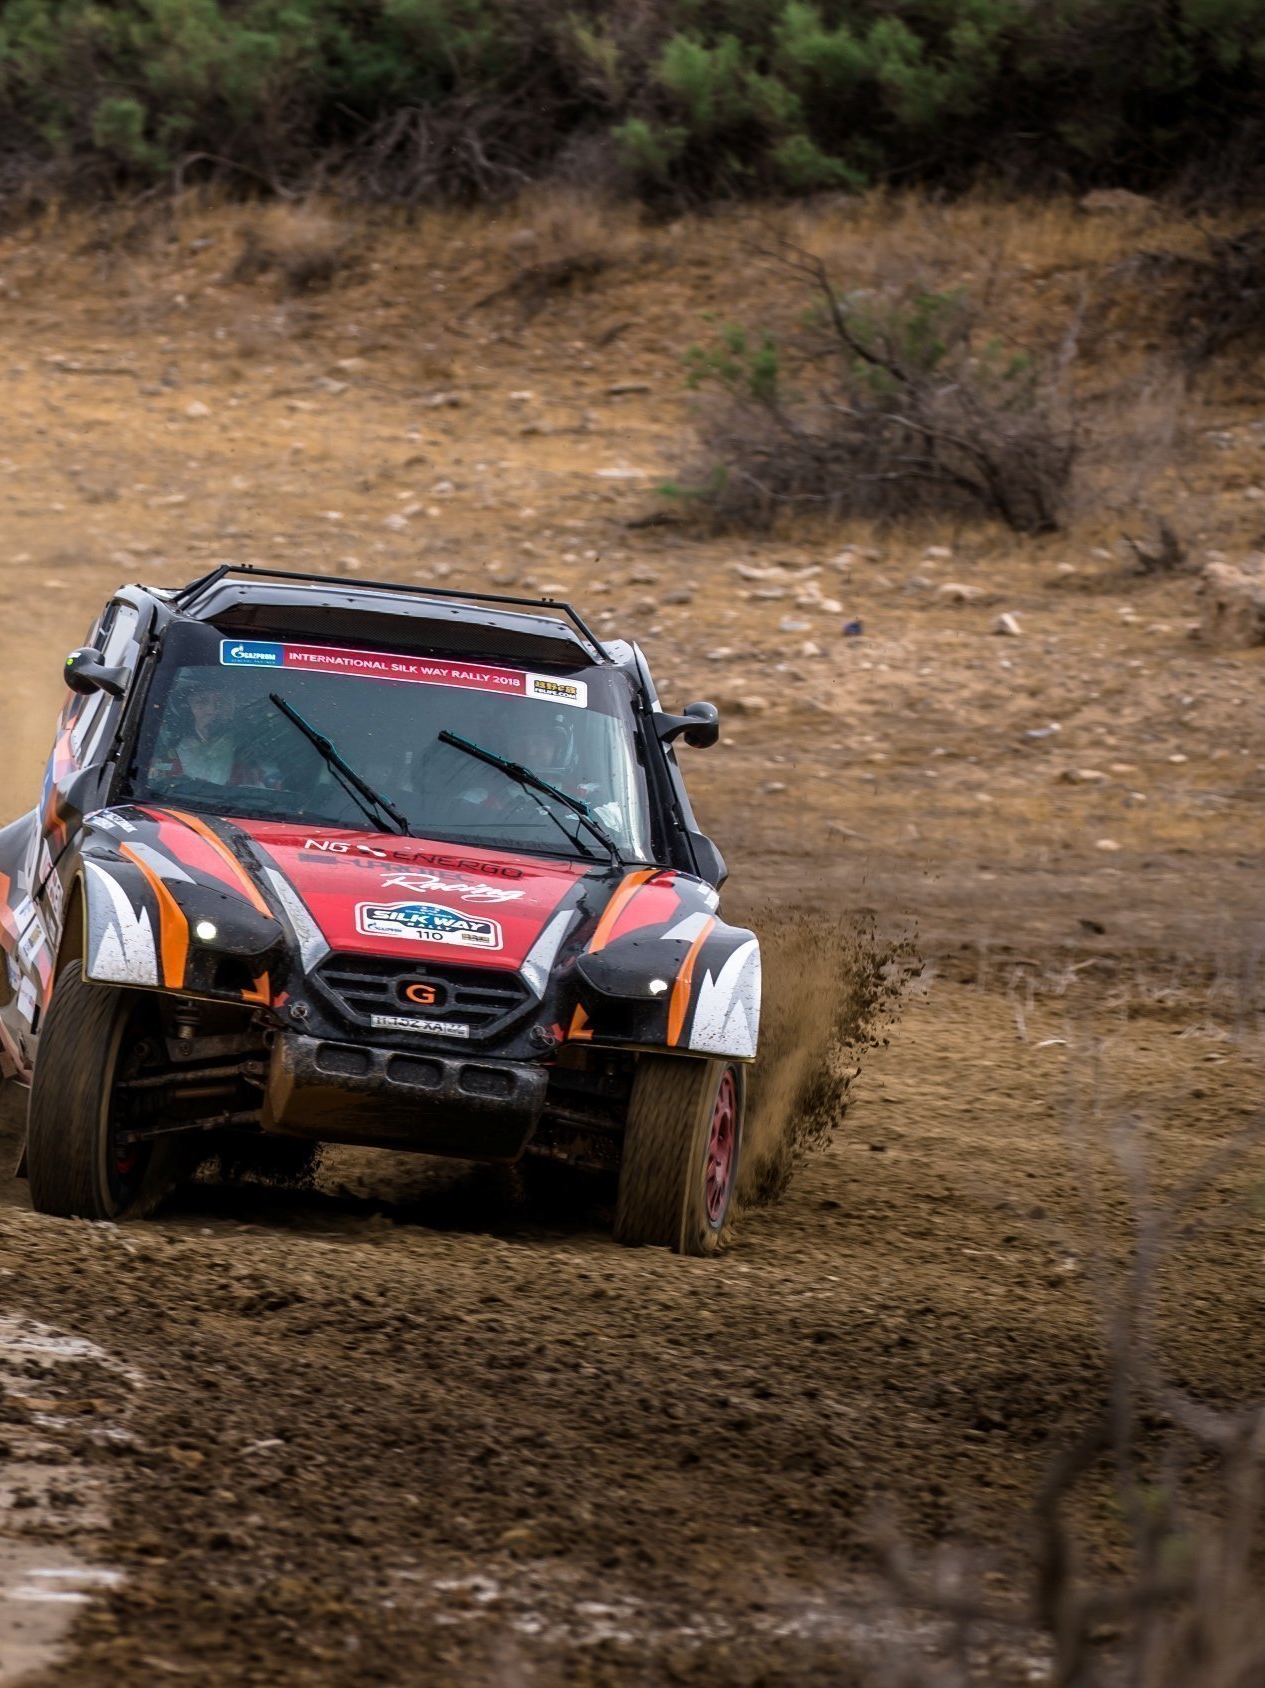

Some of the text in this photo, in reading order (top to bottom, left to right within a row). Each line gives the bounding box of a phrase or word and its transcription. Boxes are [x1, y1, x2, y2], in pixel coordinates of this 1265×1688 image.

[289, 652, 388, 671] INTERNATIONAL
[391, 663, 418, 674] SILK
[421, 666, 449, 677] WAY
[451, 670, 490, 682] RALLY
[493, 675, 521, 687] 2018
[304, 839, 524, 881] NG ENERGO
[379, 872, 526, 904] Racing
[372, 910, 429, 924] SILK
[434, 916, 486, 931] WAY
[416, 930, 444, 941] 110
